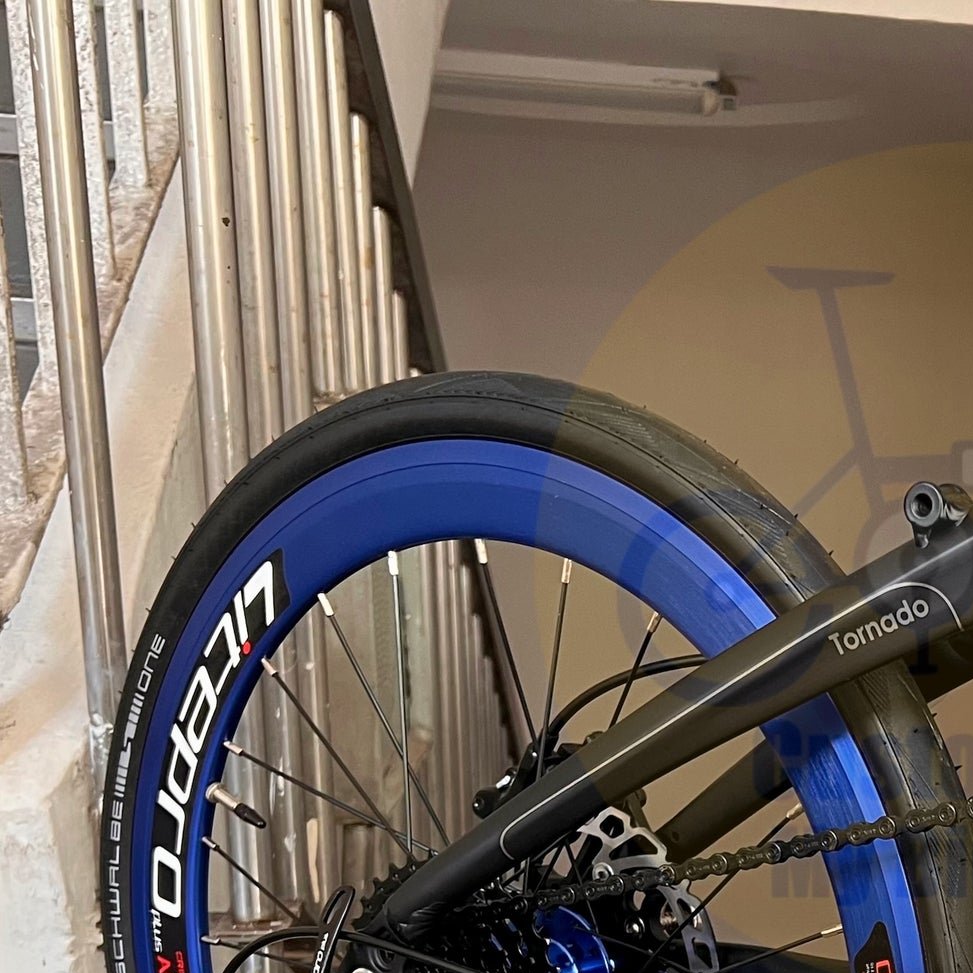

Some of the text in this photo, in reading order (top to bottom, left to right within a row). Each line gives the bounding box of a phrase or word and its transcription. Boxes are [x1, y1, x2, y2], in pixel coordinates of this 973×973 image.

[828, 596, 931, 658] Tornado
[137, 632, 167, 695] ONE
[151, 560, 275, 918] Litepro
